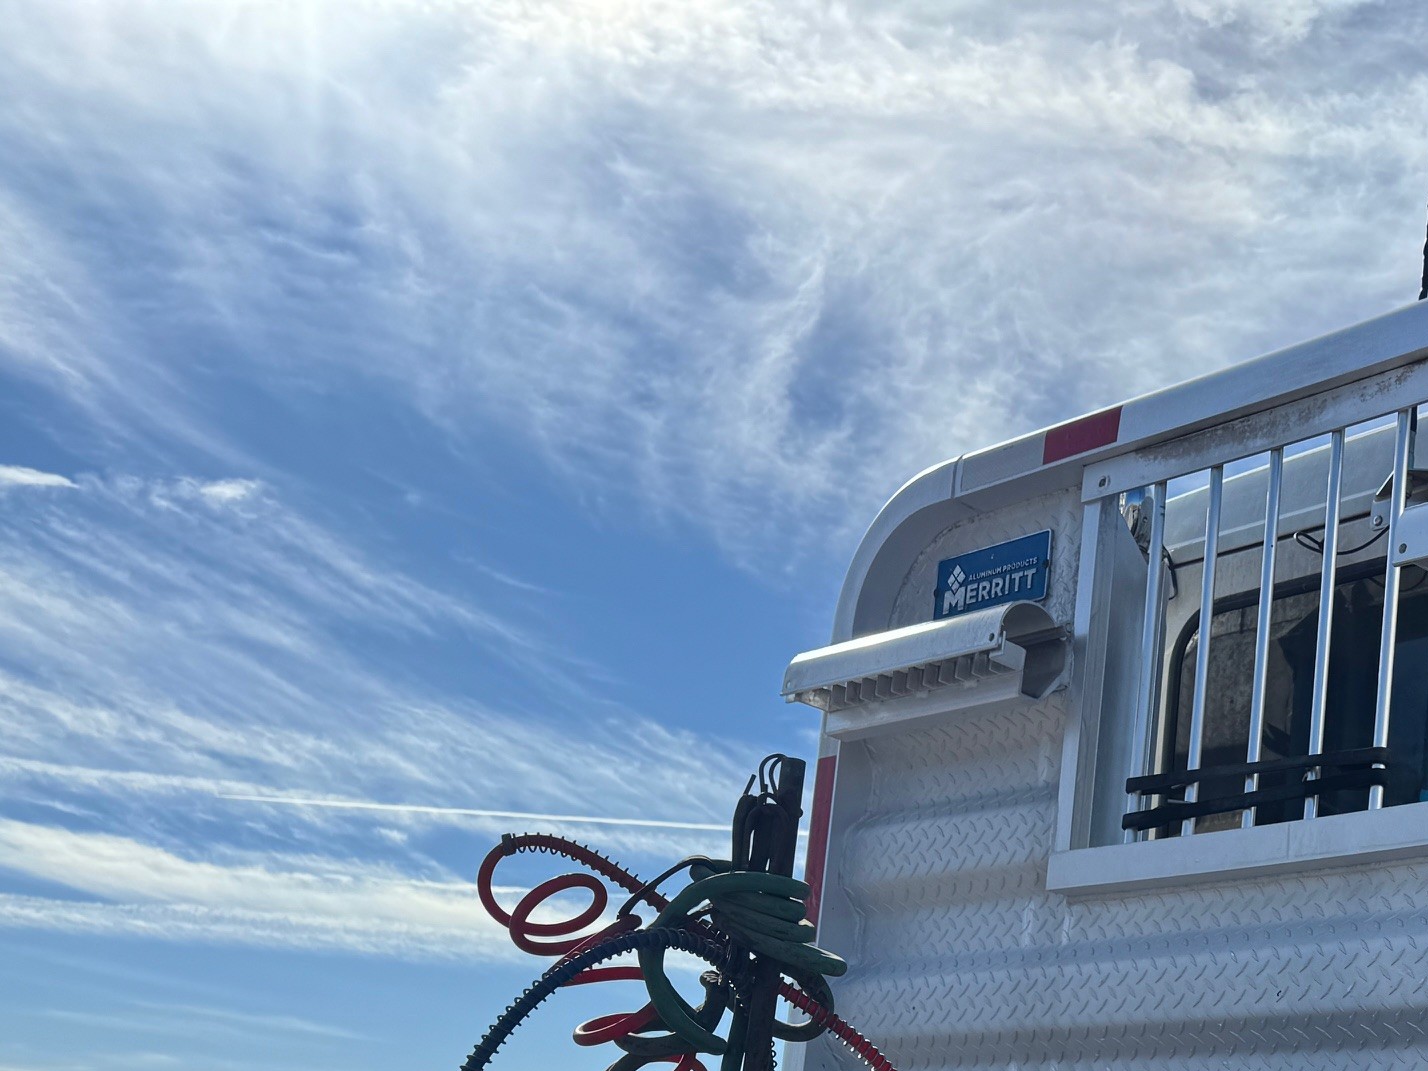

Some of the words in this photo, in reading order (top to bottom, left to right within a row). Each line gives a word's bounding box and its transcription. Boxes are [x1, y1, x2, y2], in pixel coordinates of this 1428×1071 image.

[968, 566, 1002, 581] ALUMINUM
[1002, 557, 1038, 573] PRODUCTS
[942, 568, 1037, 615] MERRITT
